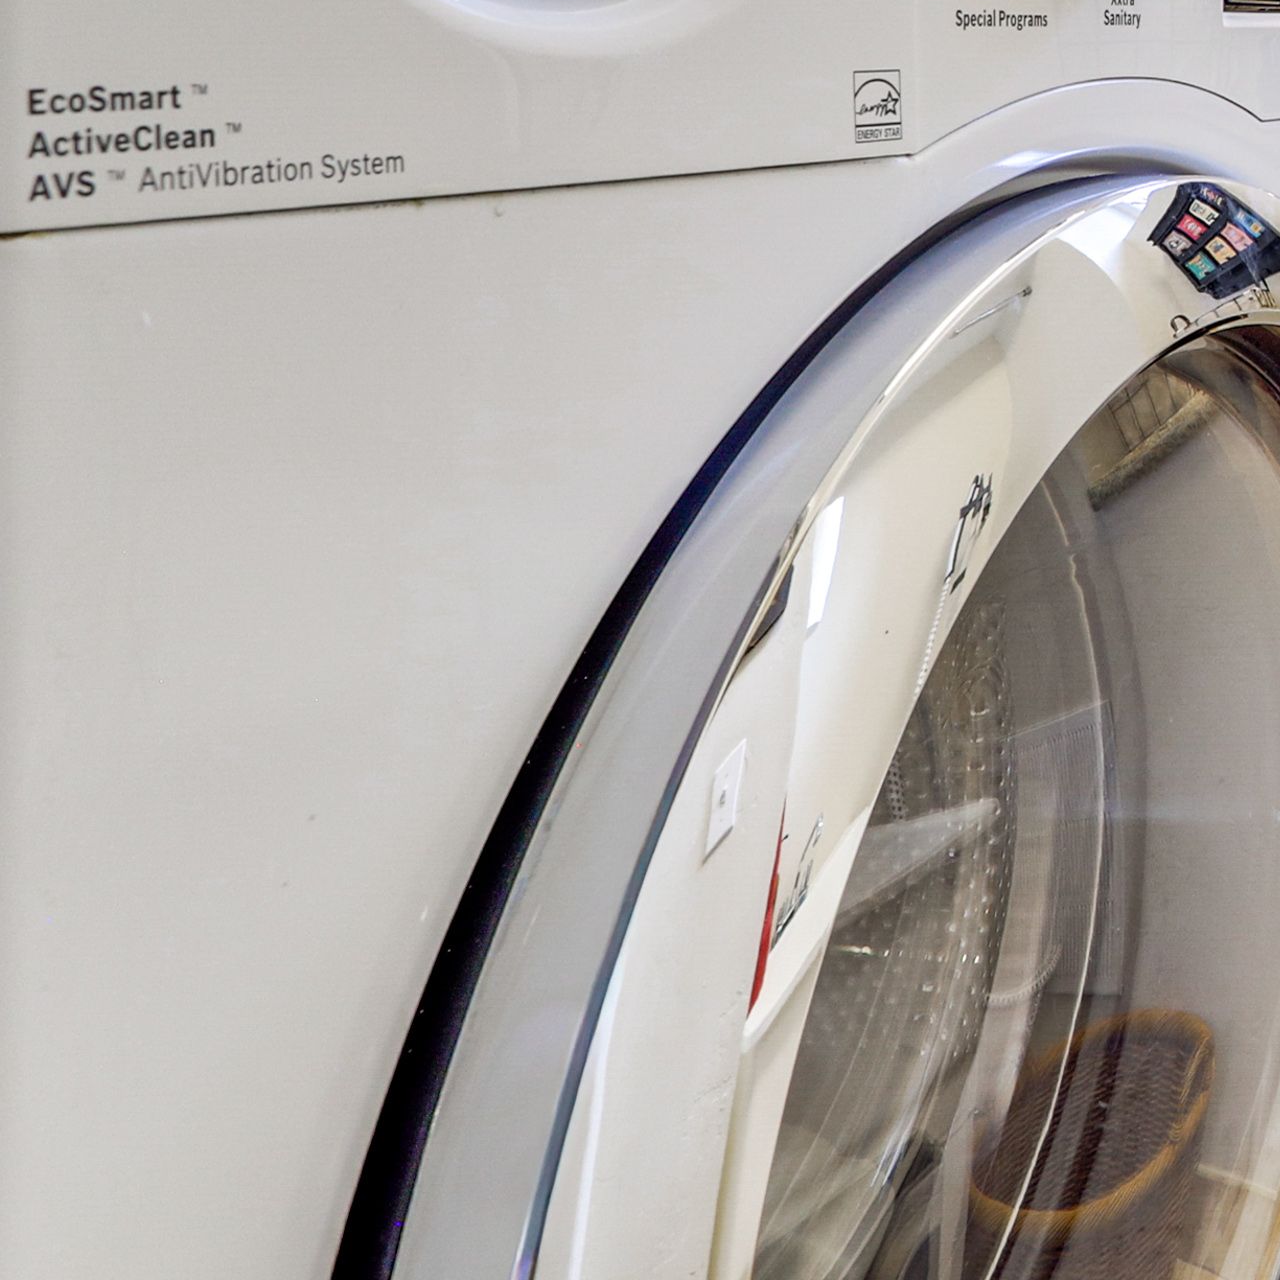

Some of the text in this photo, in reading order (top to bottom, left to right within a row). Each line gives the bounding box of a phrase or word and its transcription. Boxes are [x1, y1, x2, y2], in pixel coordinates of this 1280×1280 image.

[955, 9, 1048, 31] Special Programs
[1104, 9, 1141, 29] Sanitary
[28, 85, 182, 115] EcoSmart
[28, 124, 216, 159] ActiveClean
[857, 127, 900, 140] ENERGY STAR
[28, 170, 96, 202] AVS
[138, 157, 313, 192] AntiVibration
[320, 151, 406, 184] System
